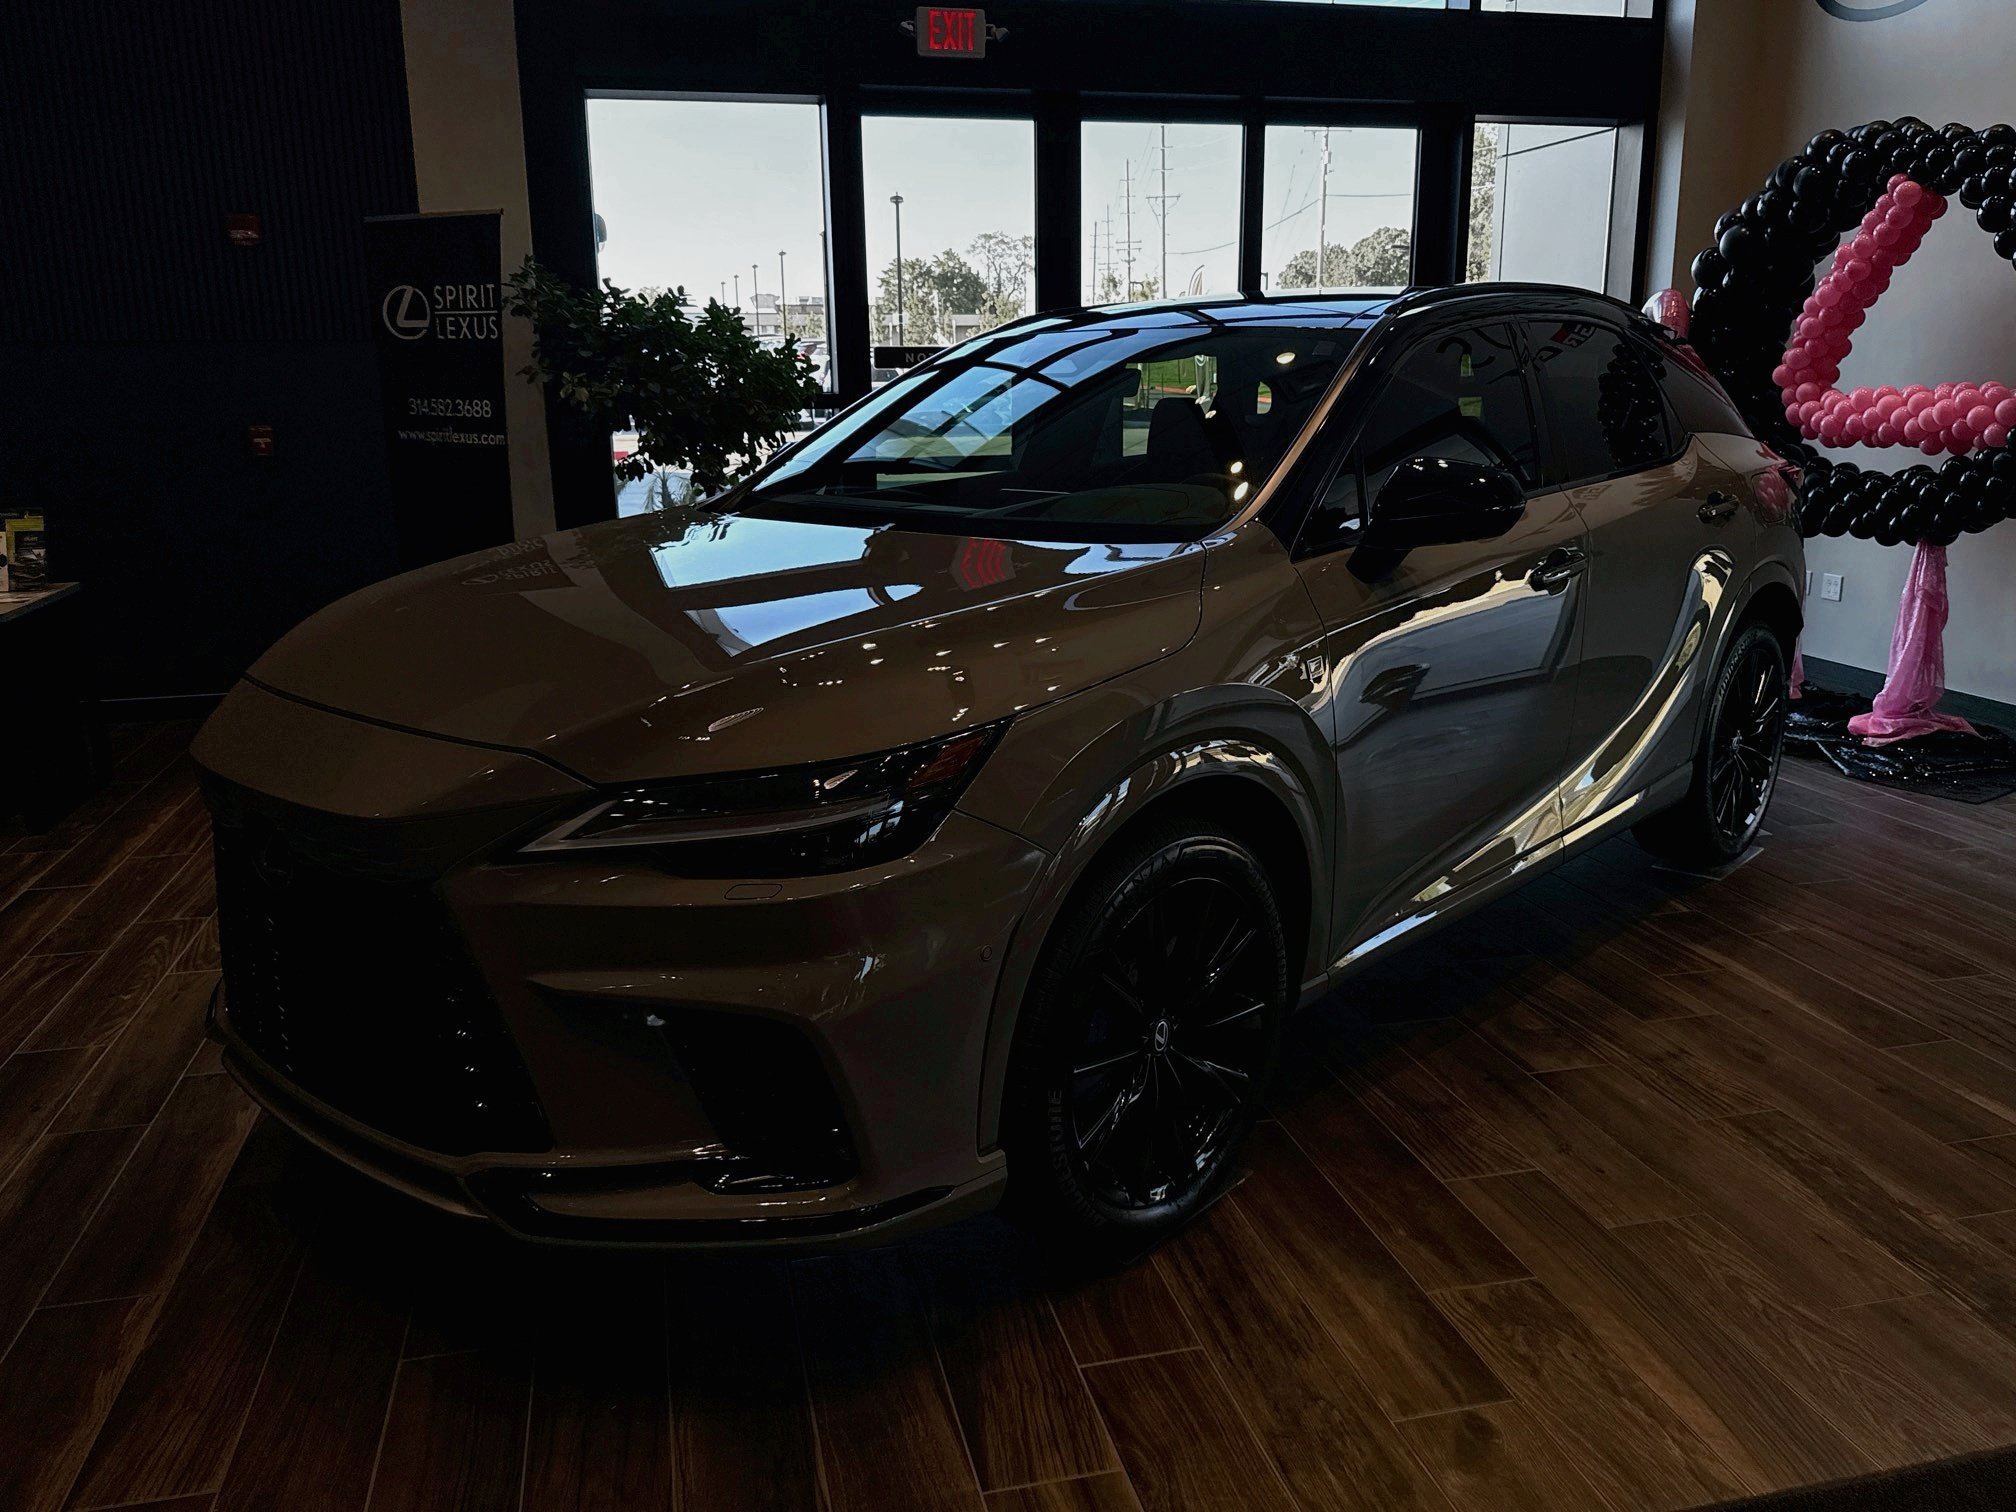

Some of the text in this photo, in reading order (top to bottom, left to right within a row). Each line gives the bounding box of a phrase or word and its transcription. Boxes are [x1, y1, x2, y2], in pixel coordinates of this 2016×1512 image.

[927, 9, 977, 51] EXIT
[433, 283, 496, 309] SPIRIT
[435, 315, 499, 340] LEXUS
[396, 426, 507, 446] www.spiritlexus.com
